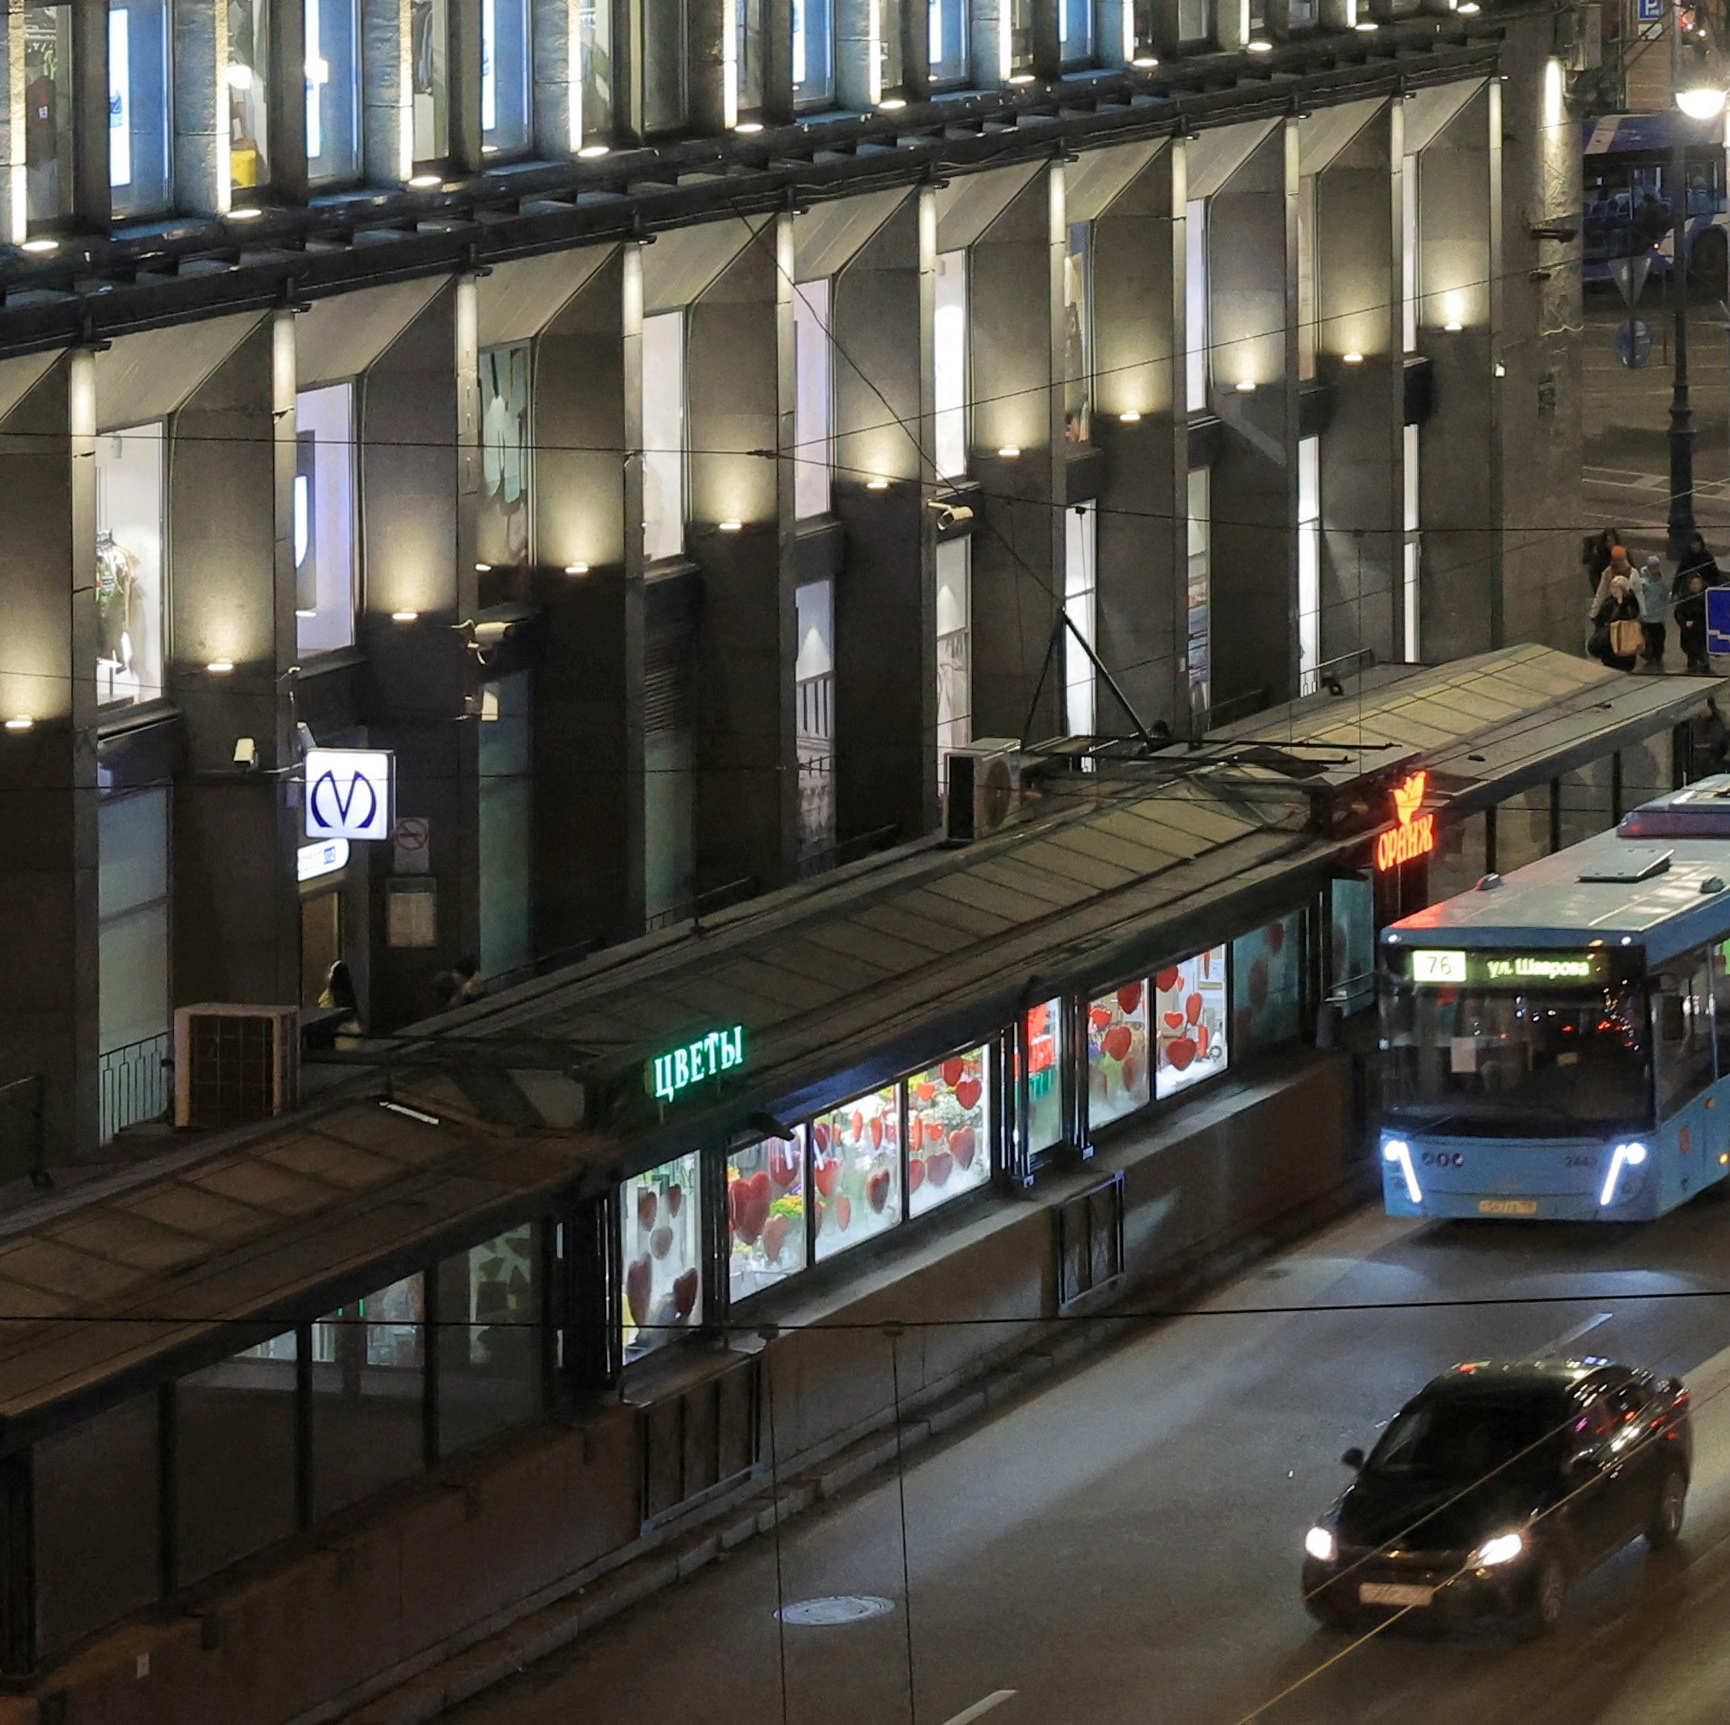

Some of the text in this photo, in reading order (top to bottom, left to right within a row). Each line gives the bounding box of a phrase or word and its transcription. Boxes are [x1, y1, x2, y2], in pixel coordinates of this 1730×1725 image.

[1379, 814, 1434, 872] ОРАНЖ
[1428, 956, 1451, 974] 76
[1488, 961, 1512, 978] ул.
[654, 1025, 743, 1102] ЦВЕТЫ
